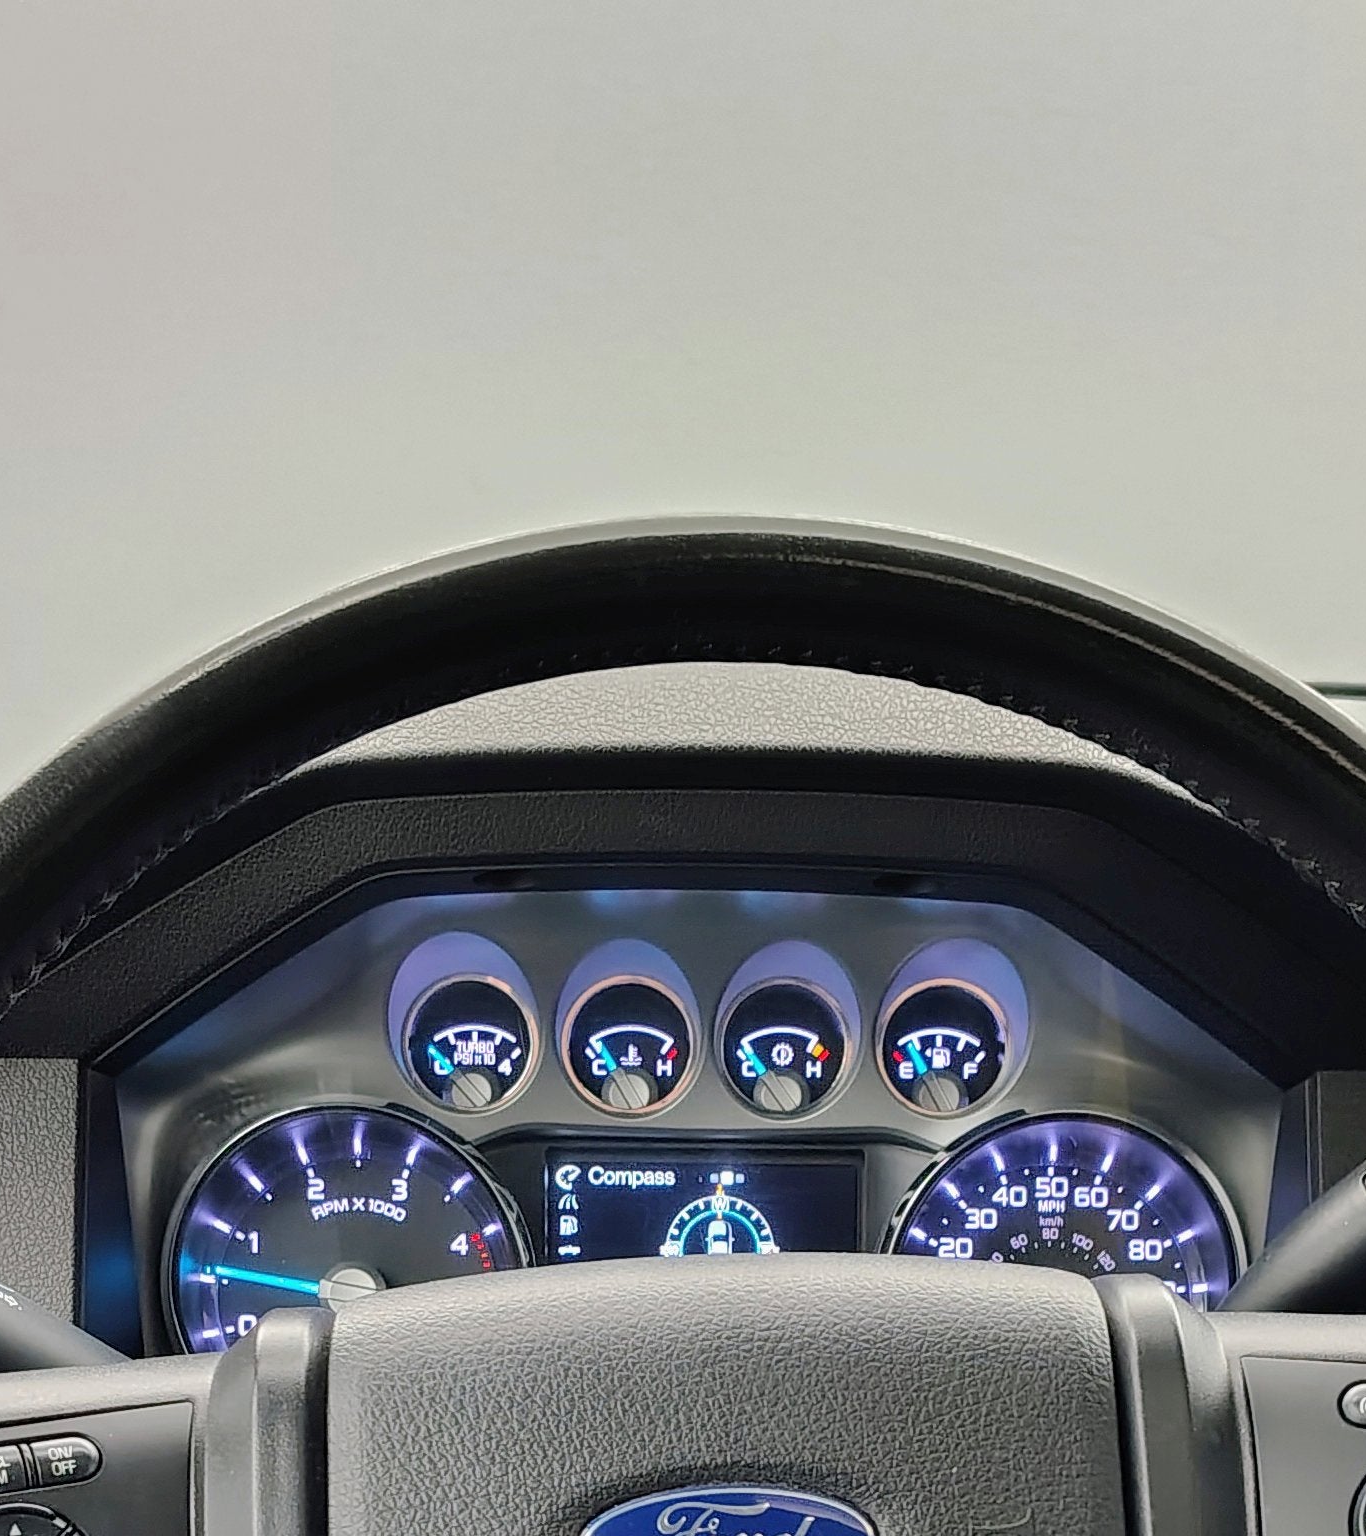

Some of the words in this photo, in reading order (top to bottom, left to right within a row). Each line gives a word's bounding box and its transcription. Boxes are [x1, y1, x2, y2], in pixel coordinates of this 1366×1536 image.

[455, 1039, 495, 1054] TURBO
[453, 1051, 474, 1066] PSI
[497, 1058, 513, 1077] 4
[591, 1058, 608, 1077] C
[656, 1059, 673, 1077] H
[741, 1060, 757, 1078] C
[805, 1060, 823, 1079] H
[898, 1061, 915, 1079] E
[962, 1062, 979, 1080] F
[587, 1165, 677, 1190] Compass
[1035, 1175, 1070, 1199] 50
[306, 1177, 326, 1201] 2
[390, 1177, 409, 1202] 3
[991, 1185, 1028, 1209] 40
[1073, 1185, 1109, 1209] 60
[311, 1199, 350, 1222] RPM
[352, 1197, 366, 1213] X
[368, 1197, 408, 1223] 1000
[1037, 1199, 1067, 1214] MPH
[964, 1207, 998, 1231] 30
[1038, 1215, 1065, 1228] km/h
[1106, 1208, 1140, 1232] 70
[247, 1230, 260, 1255] 1
[1008, 1232, 1029, 1250] 60
[1041, 1227, 1060, 1240] 80
[1071, 1232, 1094, 1252] 100
[449, 1232, 469, 1257] 4
[938, 1236, 974, 1259] 20
[1128, 1238, 1164, 1262] 80
[1096, 1249, 1116, 1272] 120
[237, 1314, 259, 1338] 0
[50, 1460, 78, 1477] OFF
